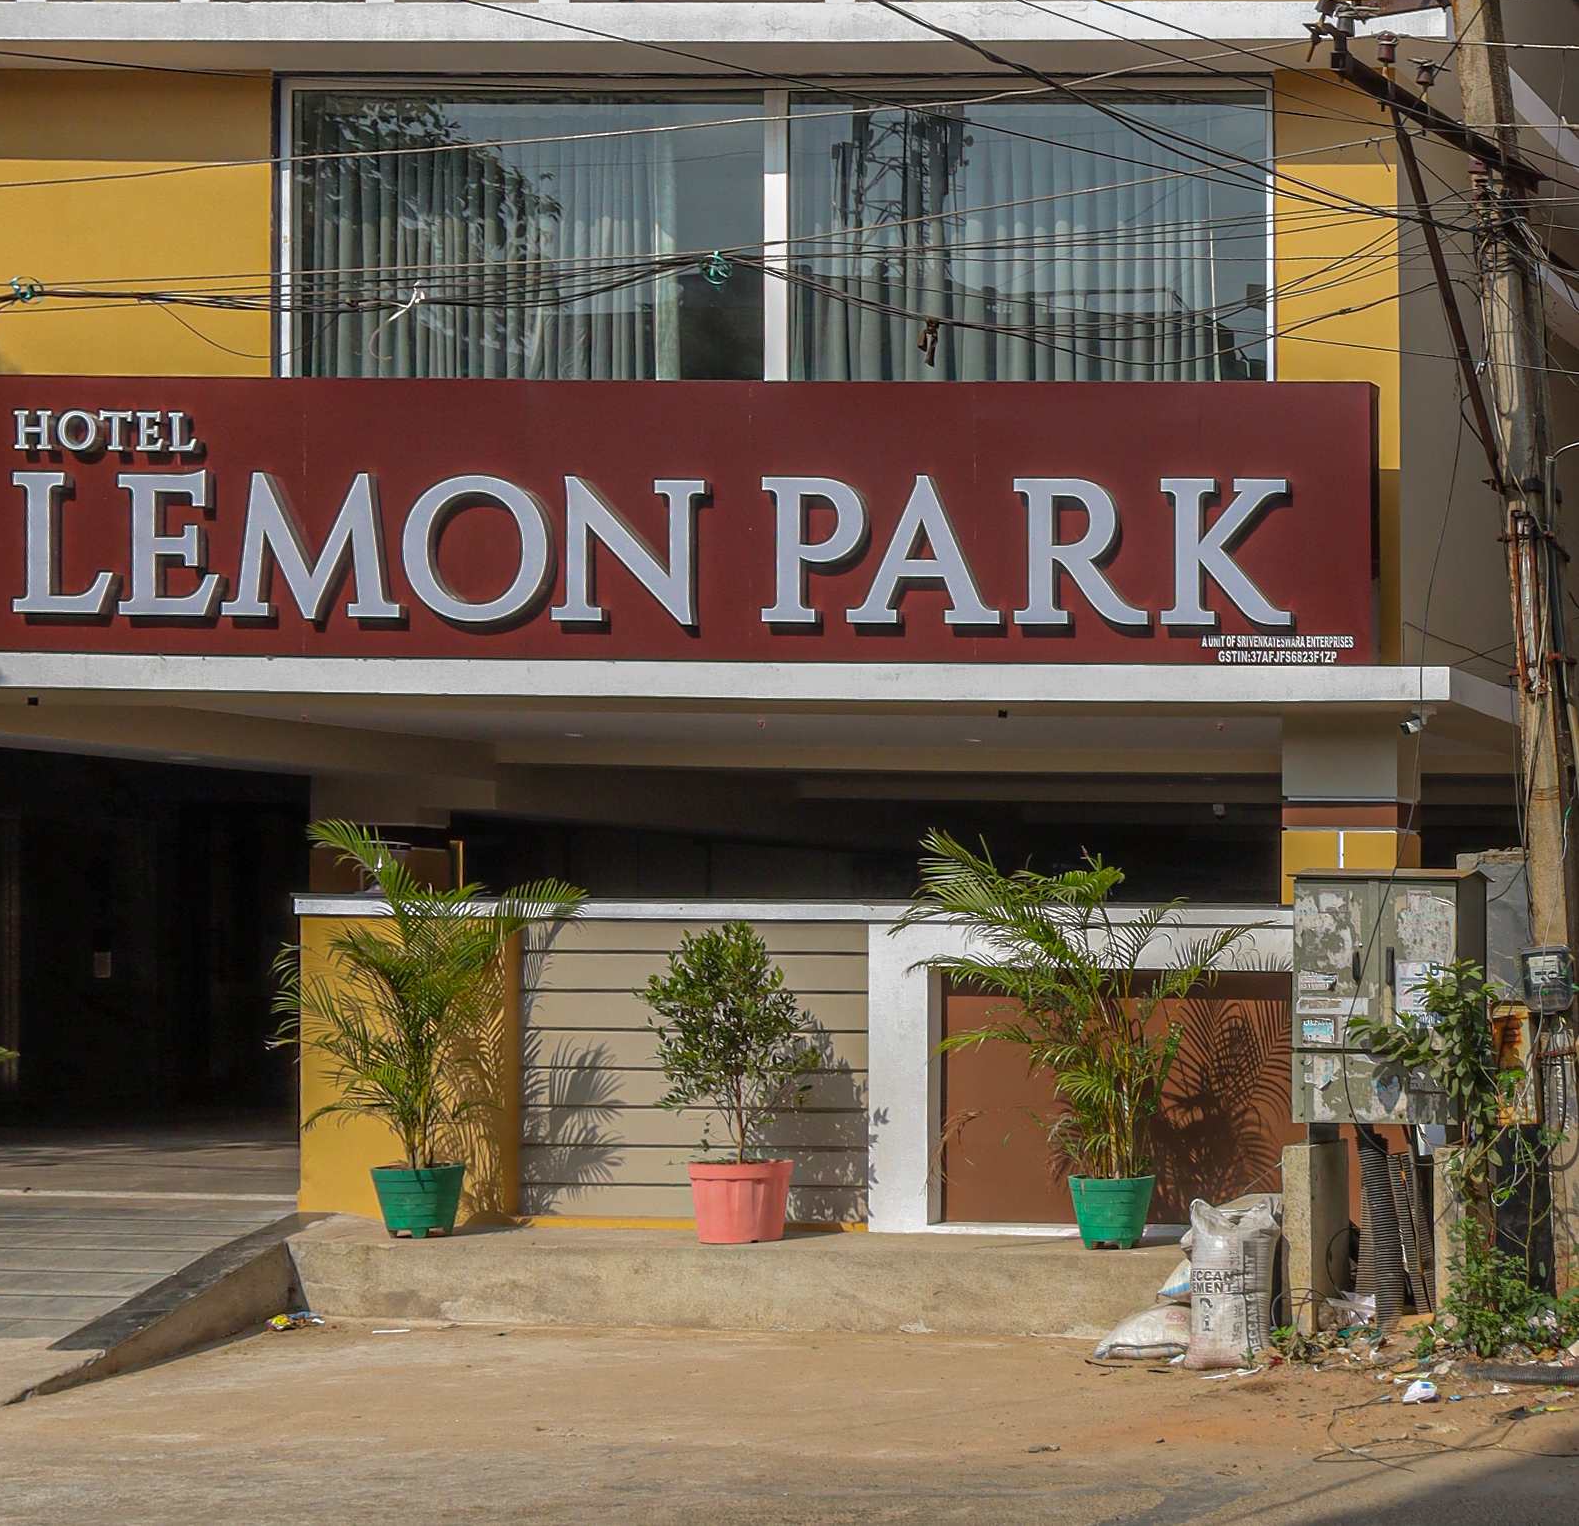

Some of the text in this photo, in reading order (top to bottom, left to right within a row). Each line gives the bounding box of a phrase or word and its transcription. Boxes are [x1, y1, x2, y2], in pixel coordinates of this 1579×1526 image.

[12, 409, 197, 451] HOTEL
[11, 469, 1294, 627] LEMON PARK
[1201, 635, 1207, 648] A
[1208, 635, 1225, 648] UNIT
[1226, 635, 1236, 648] OF
[1306, 635, 1354, 648] ENTERPRISES
[1191, 1270, 1234, 1282] ECCAN
[1191, 1282, 1234, 1293] EMENT
